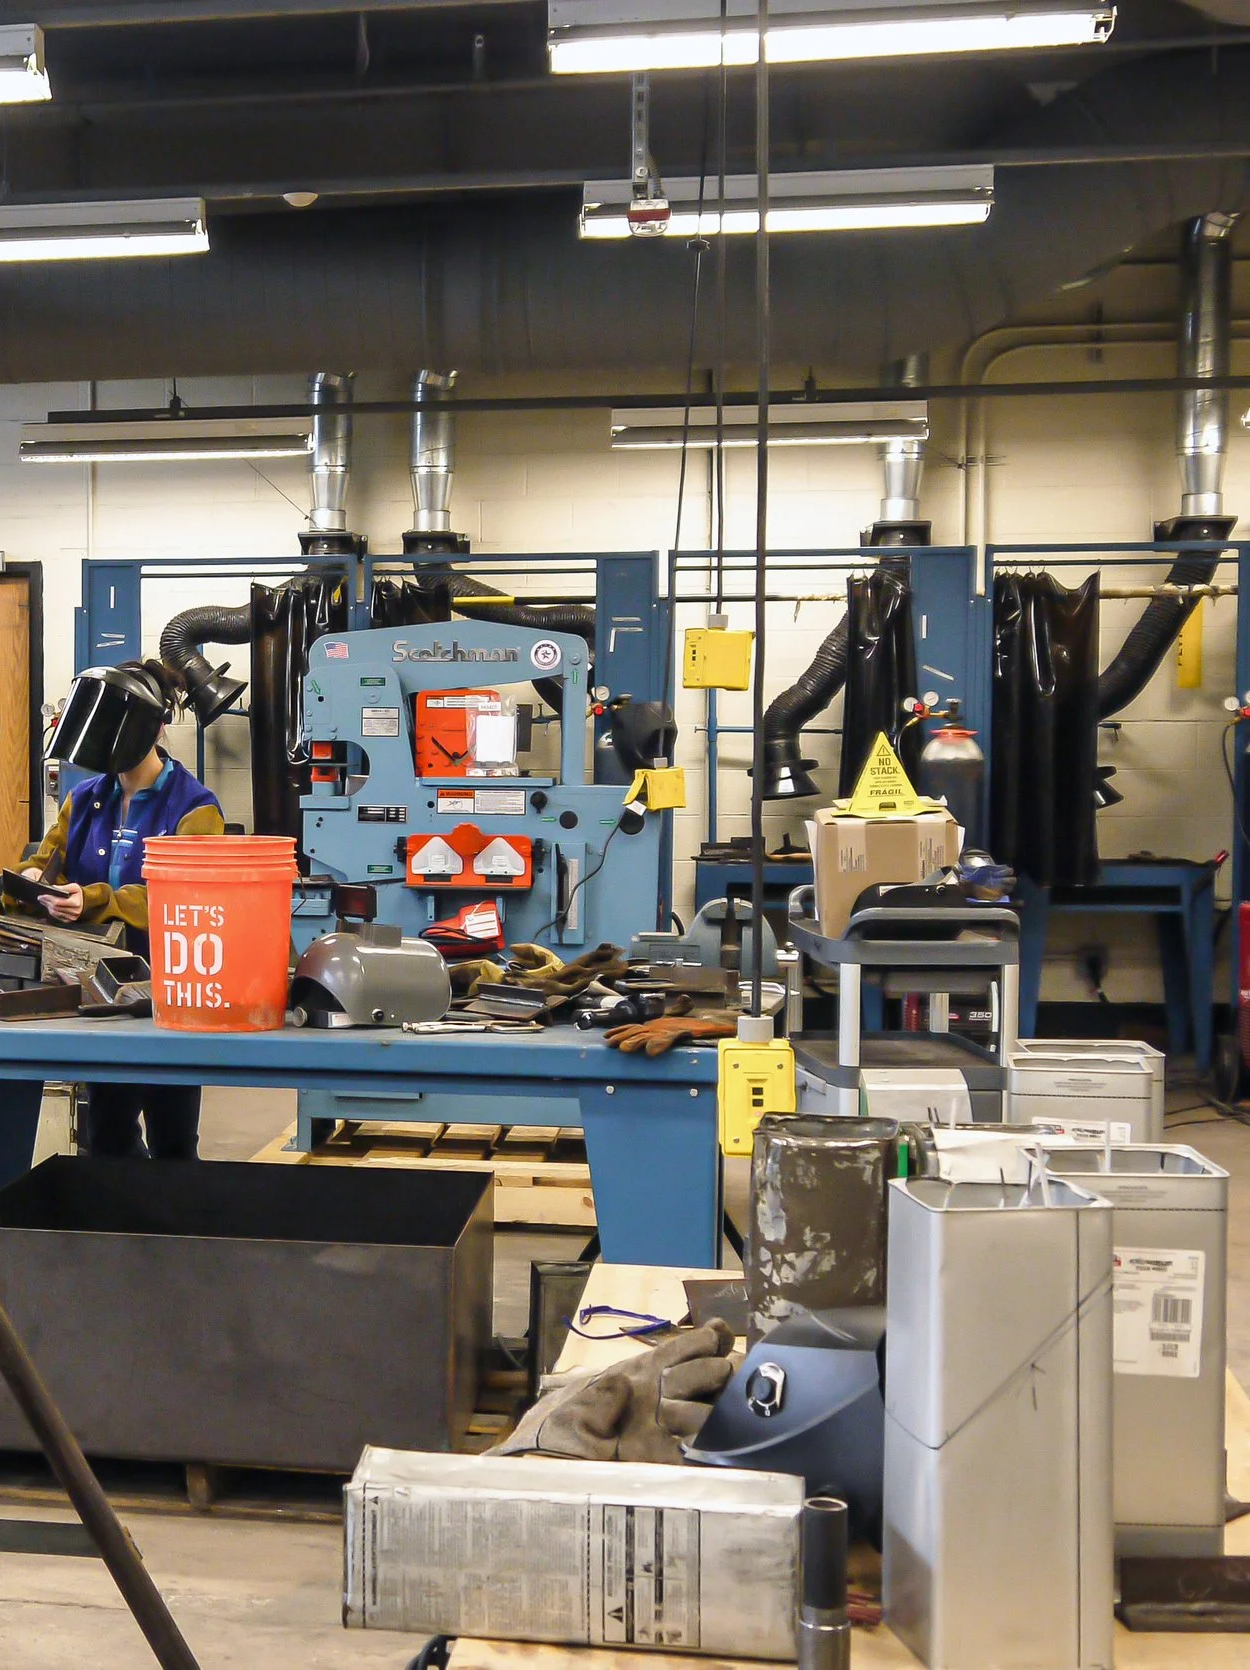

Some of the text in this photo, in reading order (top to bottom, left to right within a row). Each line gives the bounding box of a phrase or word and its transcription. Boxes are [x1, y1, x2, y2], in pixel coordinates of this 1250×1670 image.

[392, 640, 518, 663] Scotchman
[878, 757, 891, 766] NO
[163, 903, 225, 927] LET'S
[163, 931, 224, 976] DO
[163, 979, 231, 1009] THIS.
